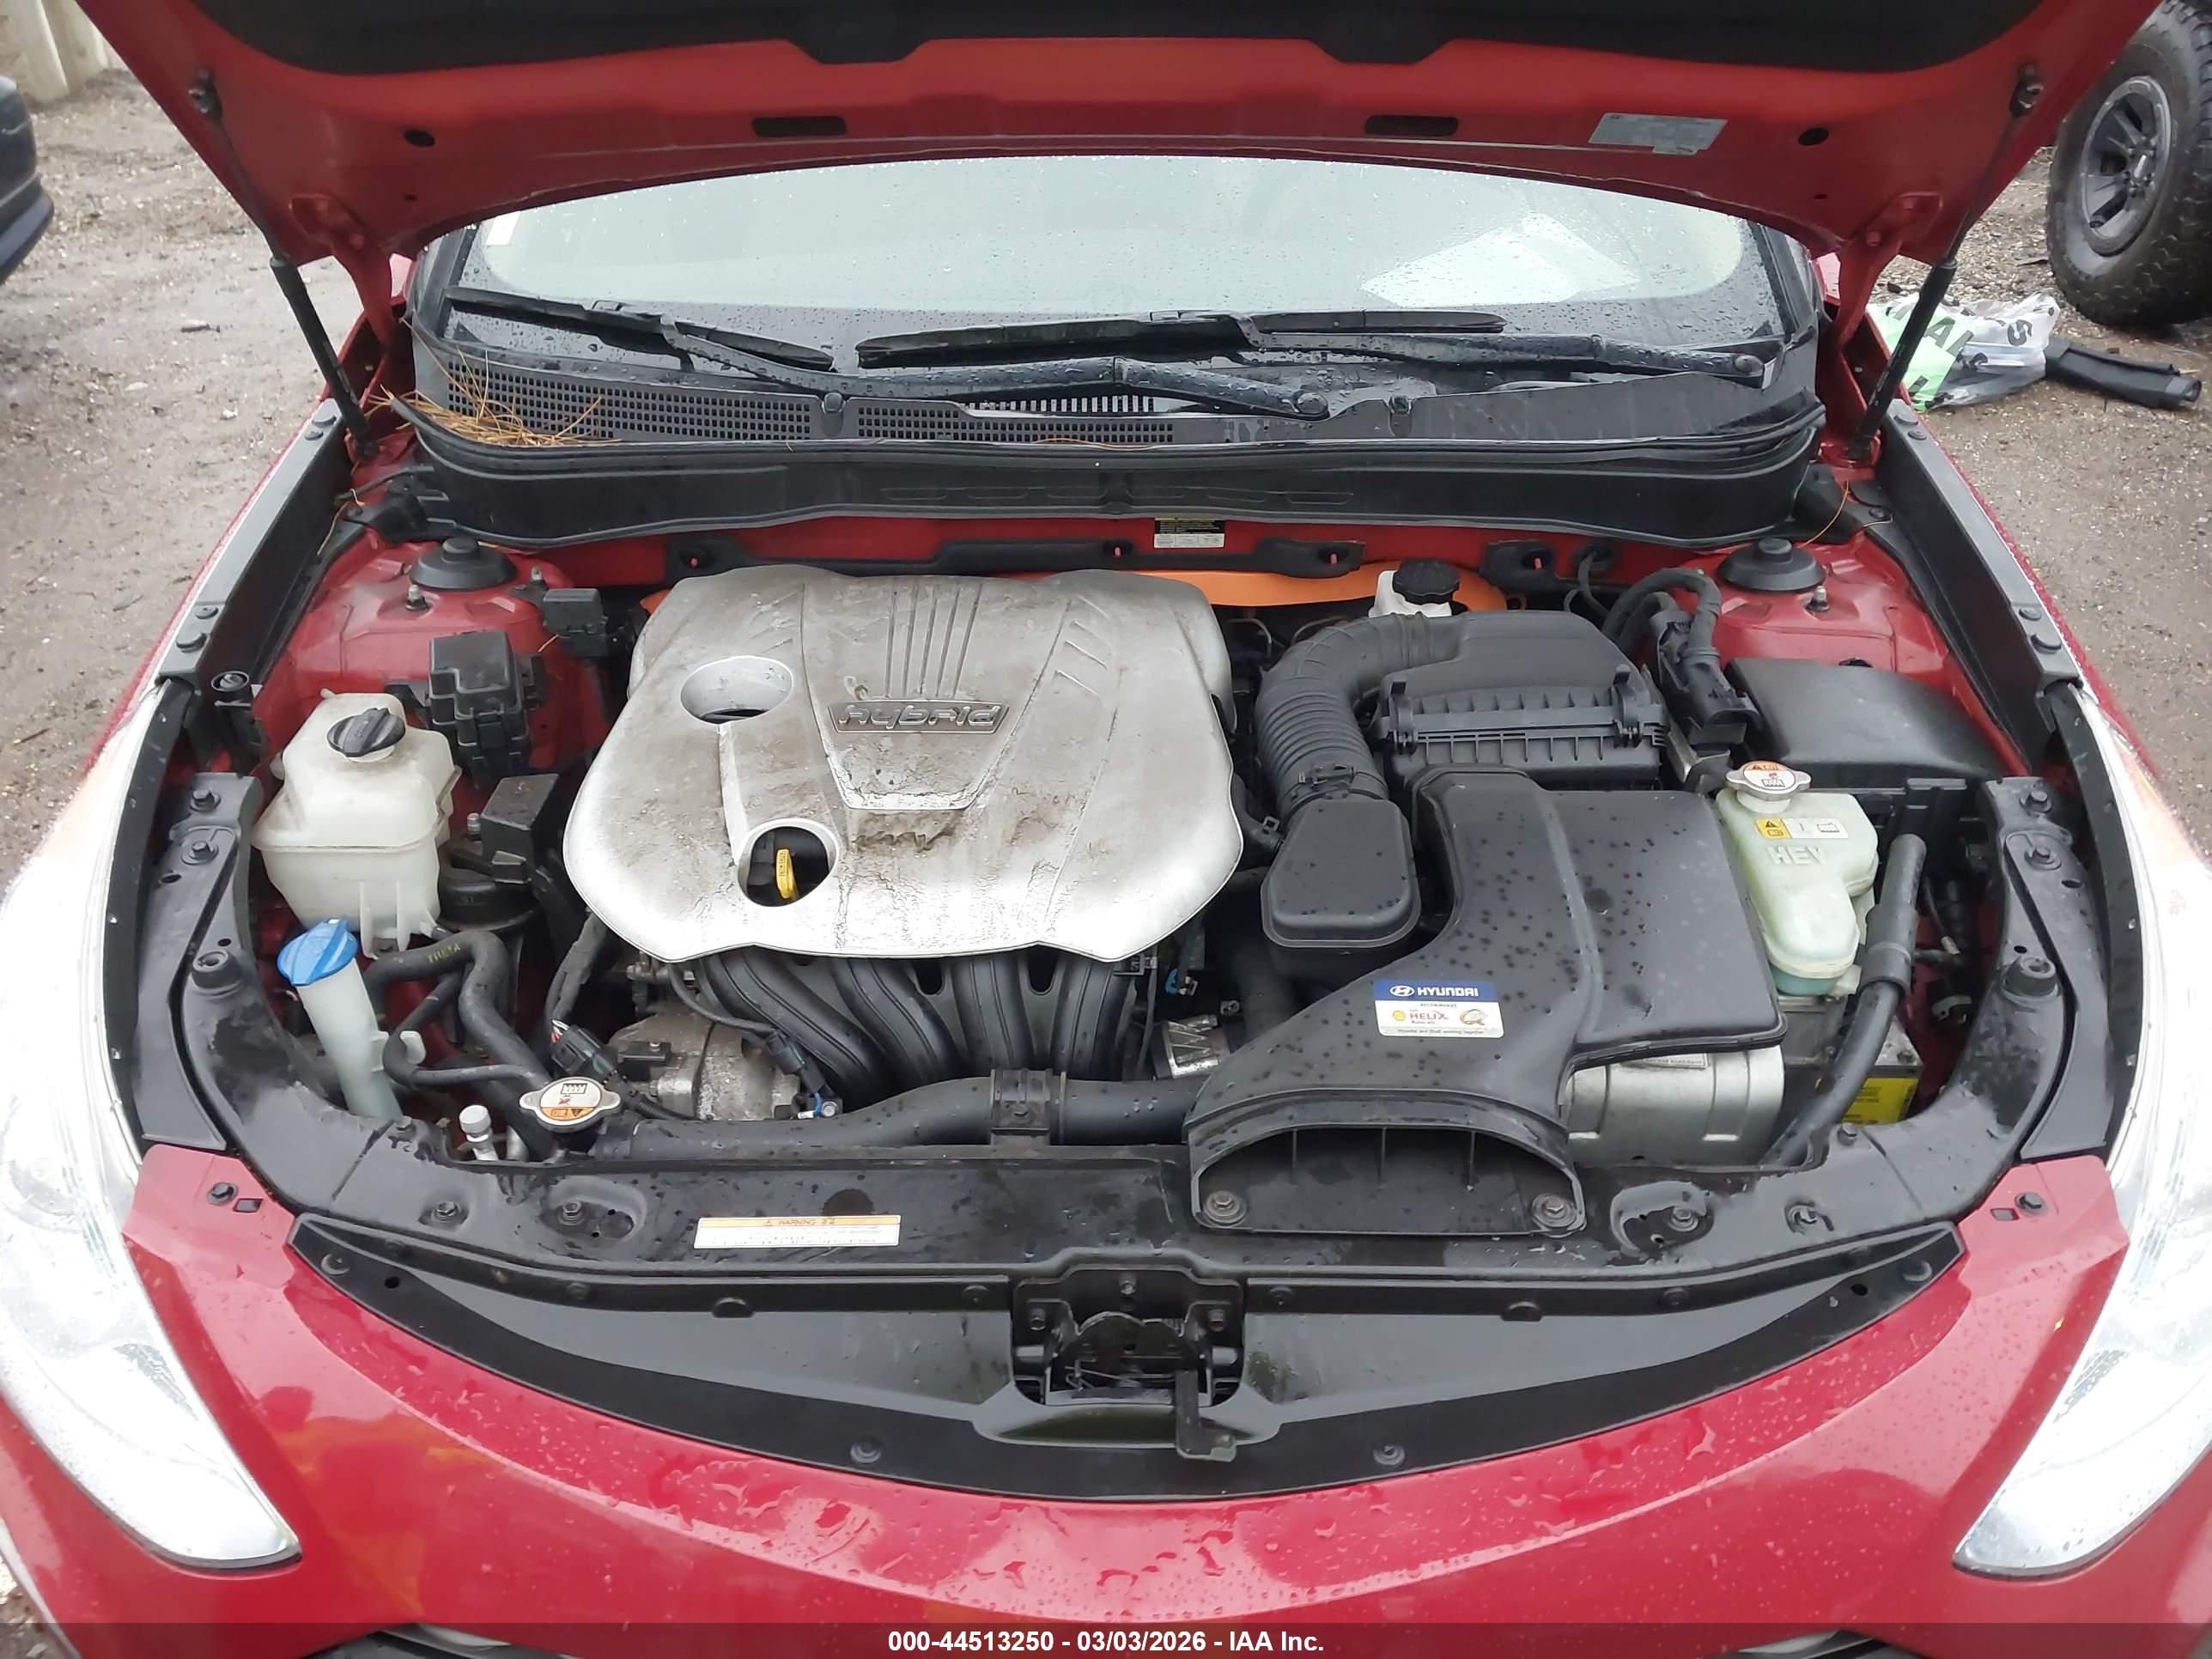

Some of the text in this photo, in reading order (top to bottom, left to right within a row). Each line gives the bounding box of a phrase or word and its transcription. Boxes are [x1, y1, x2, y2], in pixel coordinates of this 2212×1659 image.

[838, 704, 1001, 730] hybrid
[1765, 845, 1826, 866] HEV
[1418, 987, 1480, 997] HYUNDAI
[1409, 1010, 1449, 1020] HELIX
